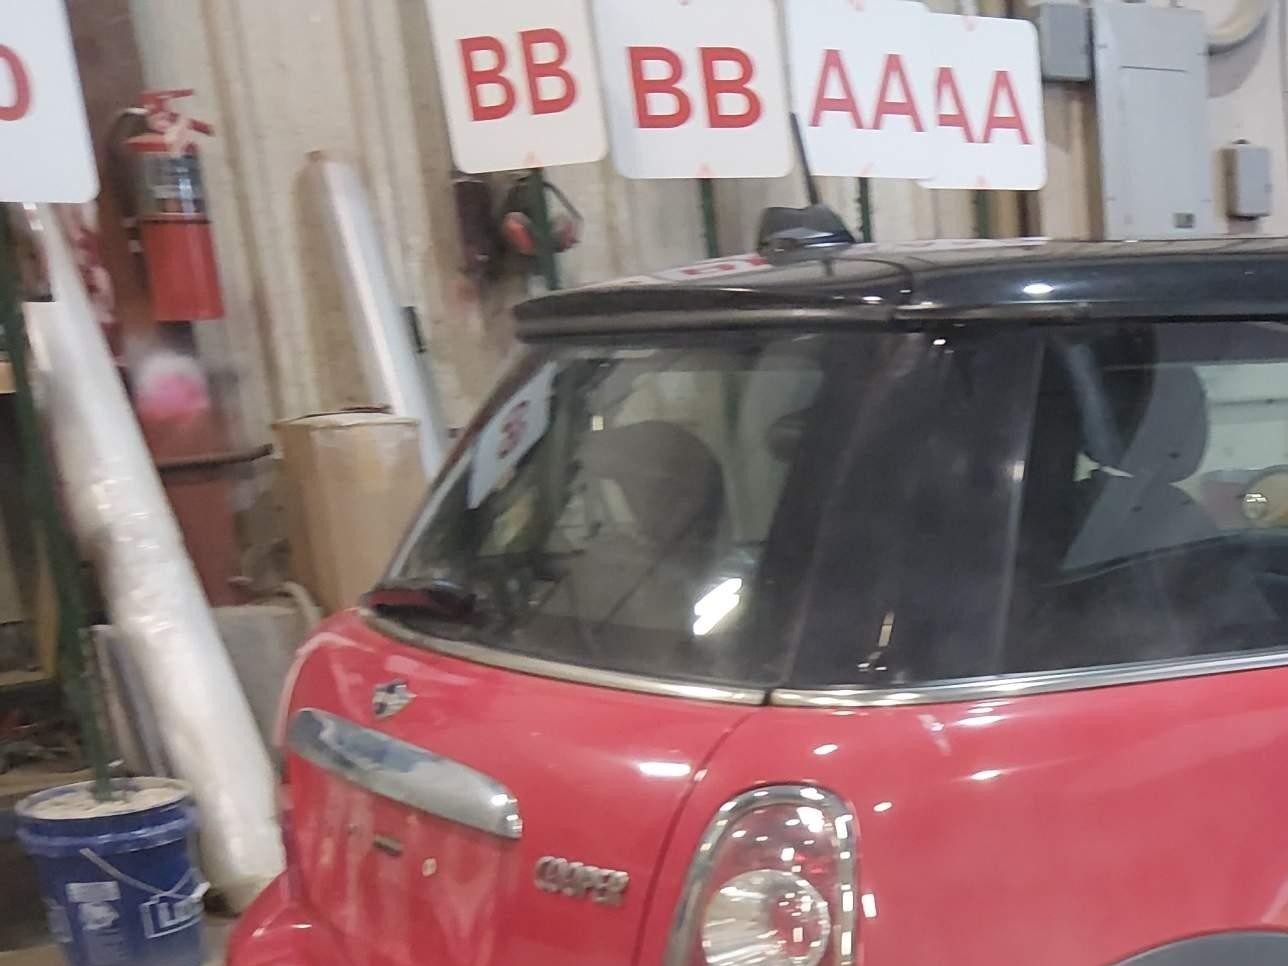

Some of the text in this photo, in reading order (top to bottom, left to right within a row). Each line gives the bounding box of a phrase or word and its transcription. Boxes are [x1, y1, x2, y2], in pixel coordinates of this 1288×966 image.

[457, 27, 577, 122] BB
[627, 45, 763, 129] BB
[809, 48, 925, 133] AA
[935, 66, 1033, 146] AA
[533, 855, 630, 906] COOPER
